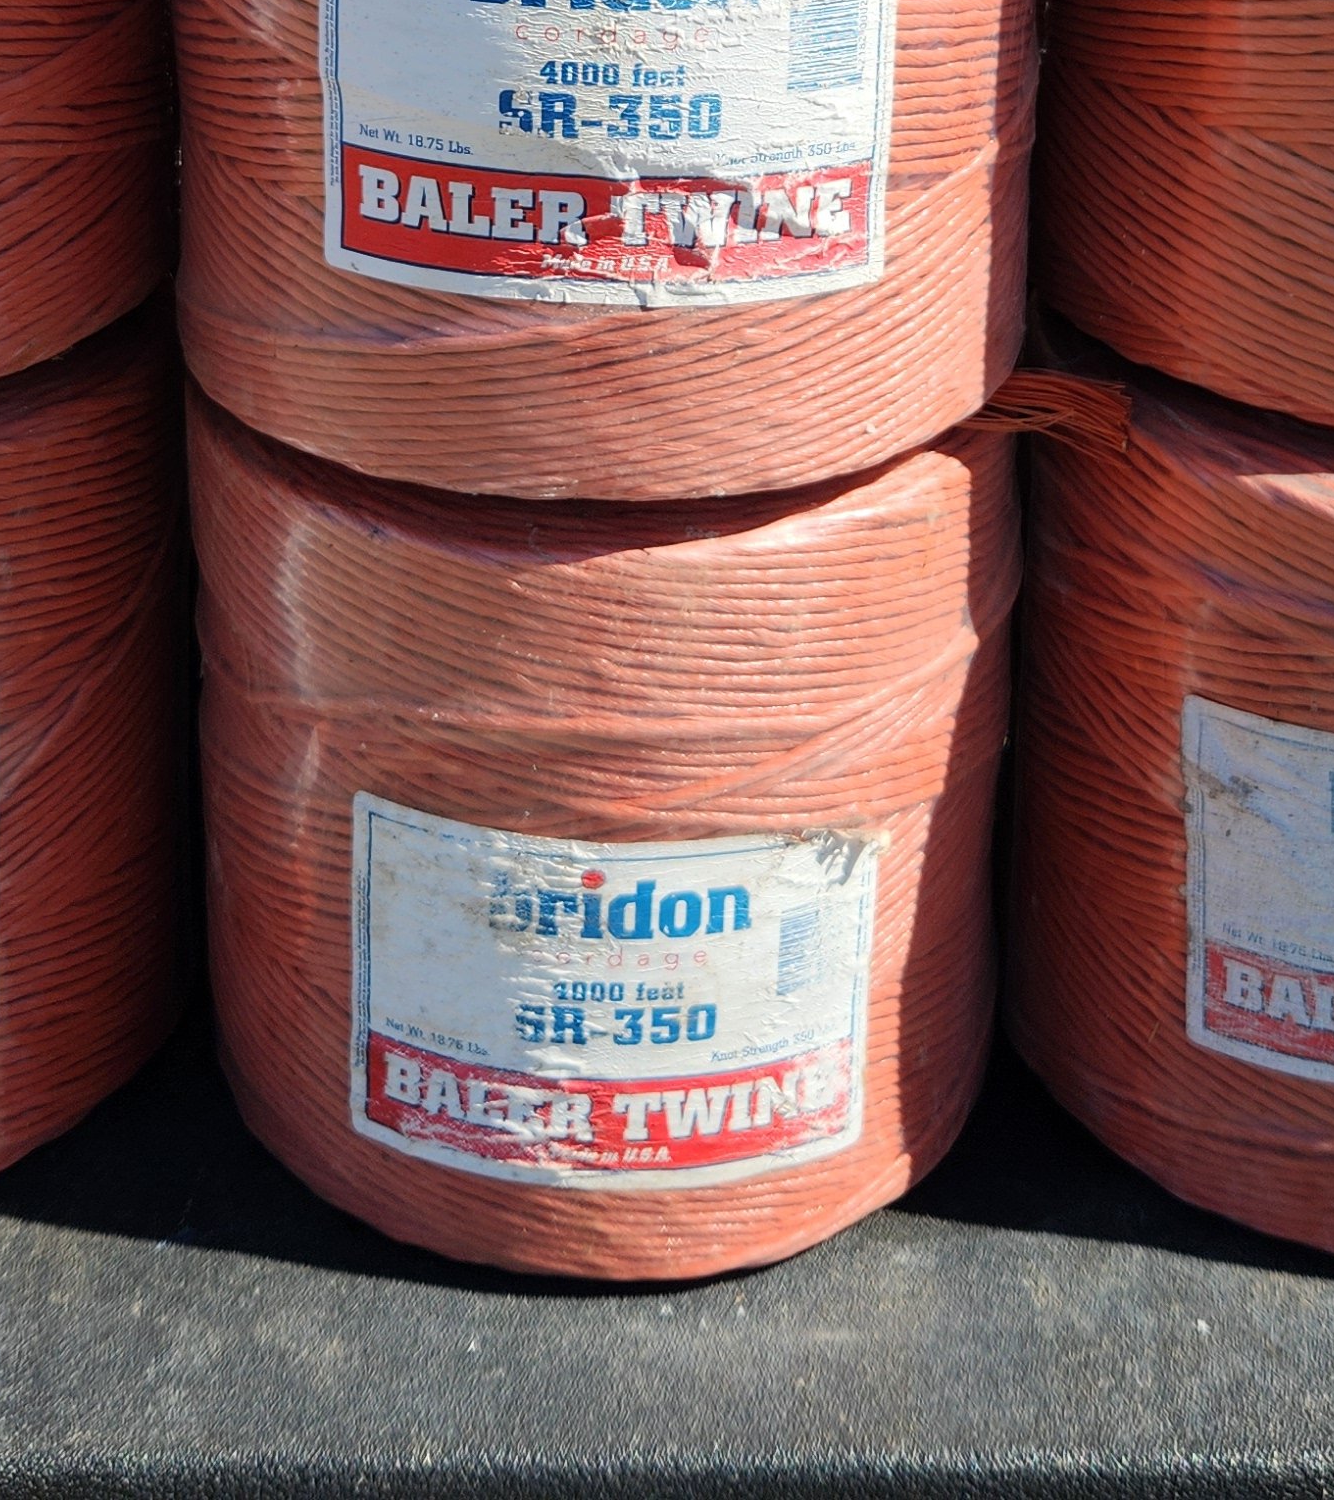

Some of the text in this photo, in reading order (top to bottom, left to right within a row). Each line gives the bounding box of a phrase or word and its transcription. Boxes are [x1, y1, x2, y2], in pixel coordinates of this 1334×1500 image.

[515, 24, 711, 50] cordage
[539, 60, 688, 88] 4000 feet
[498, 89, 723, 140] SR-350
[359, 124, 474, 156] Net Wt. 18.75 Lbs.
[807, 142, 833, 158] 350
[358, 163, 852, 248] BALER TWINE
[542, 254, 591, 270] Made
[596, 257, 618, 271] in
[489, 869, 752, 939] bridon
[635, 980, 686, 1001] feet
[385, 1016, 404, 1031] Net
[515, 1002, 717, 1045] SR-350
[742, 1036, 790, 1058] Strength
[385, 1051, 838, 1142] BALER TWINE
